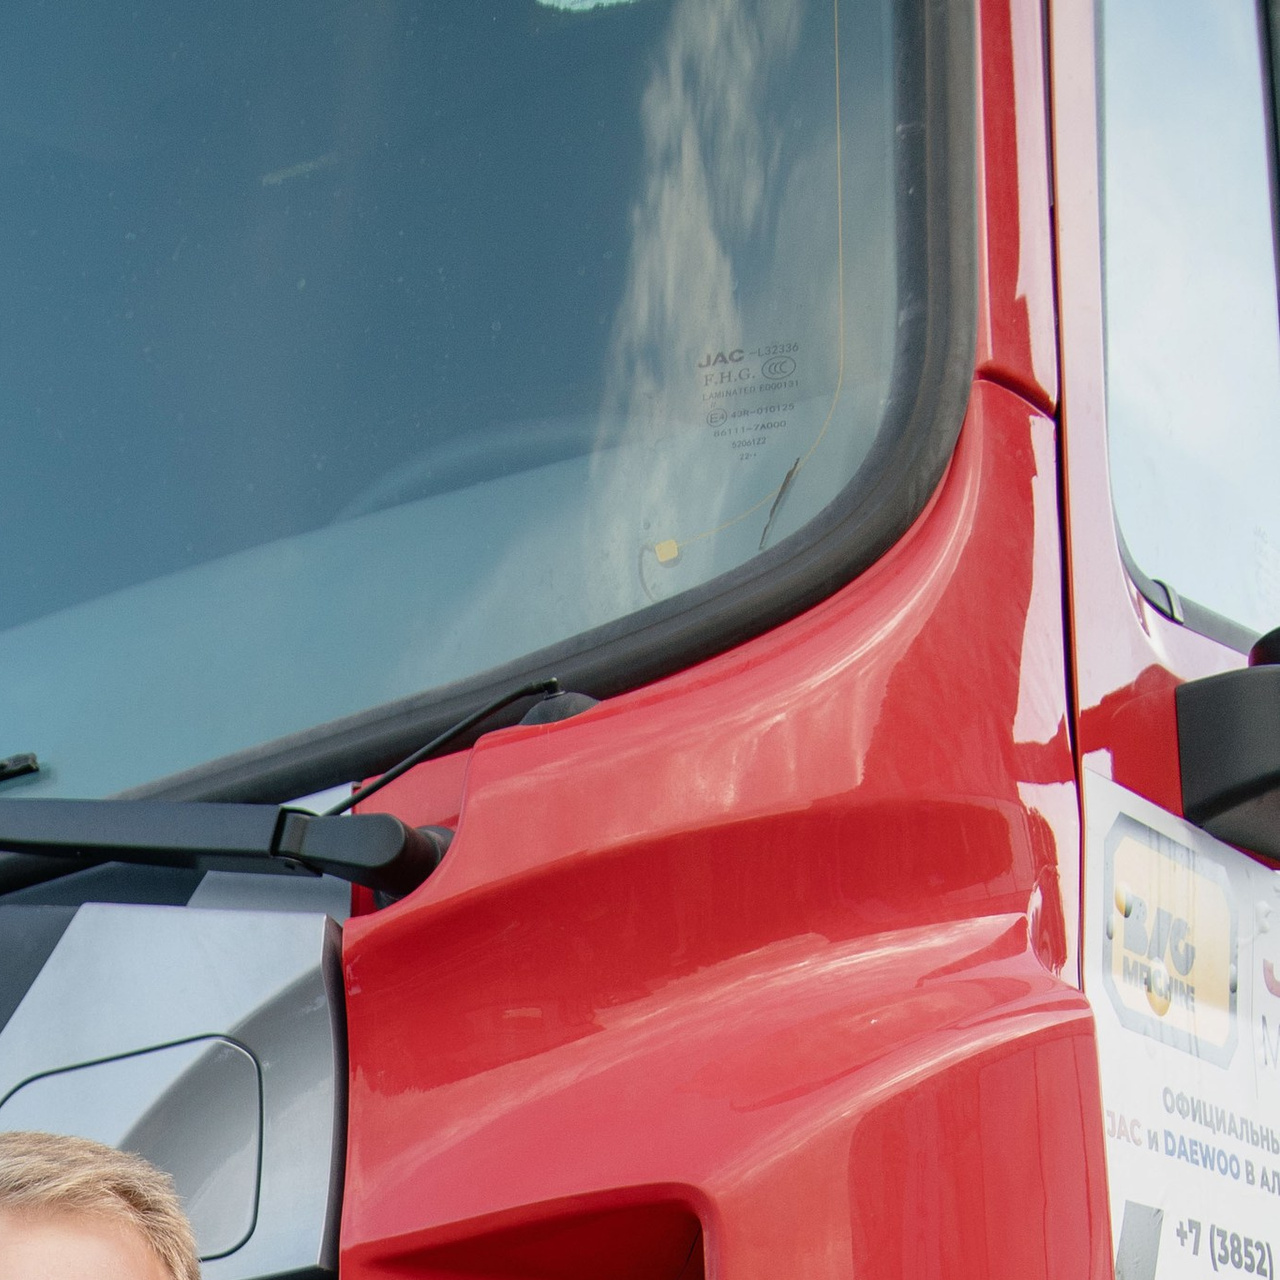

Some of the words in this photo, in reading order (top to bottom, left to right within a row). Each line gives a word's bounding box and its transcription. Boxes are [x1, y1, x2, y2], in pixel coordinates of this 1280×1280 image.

[698, 349, 744, 368] JAC
[702, 385, 756, 401] LAMINATED
[1123, 892, 1196, 977] BIG
[1106, 1110, 1142, 1147] JAC
[1164, 1129, 1241, 1181] DAEWOO
[1176, 1218, 1202, 1257] +7
